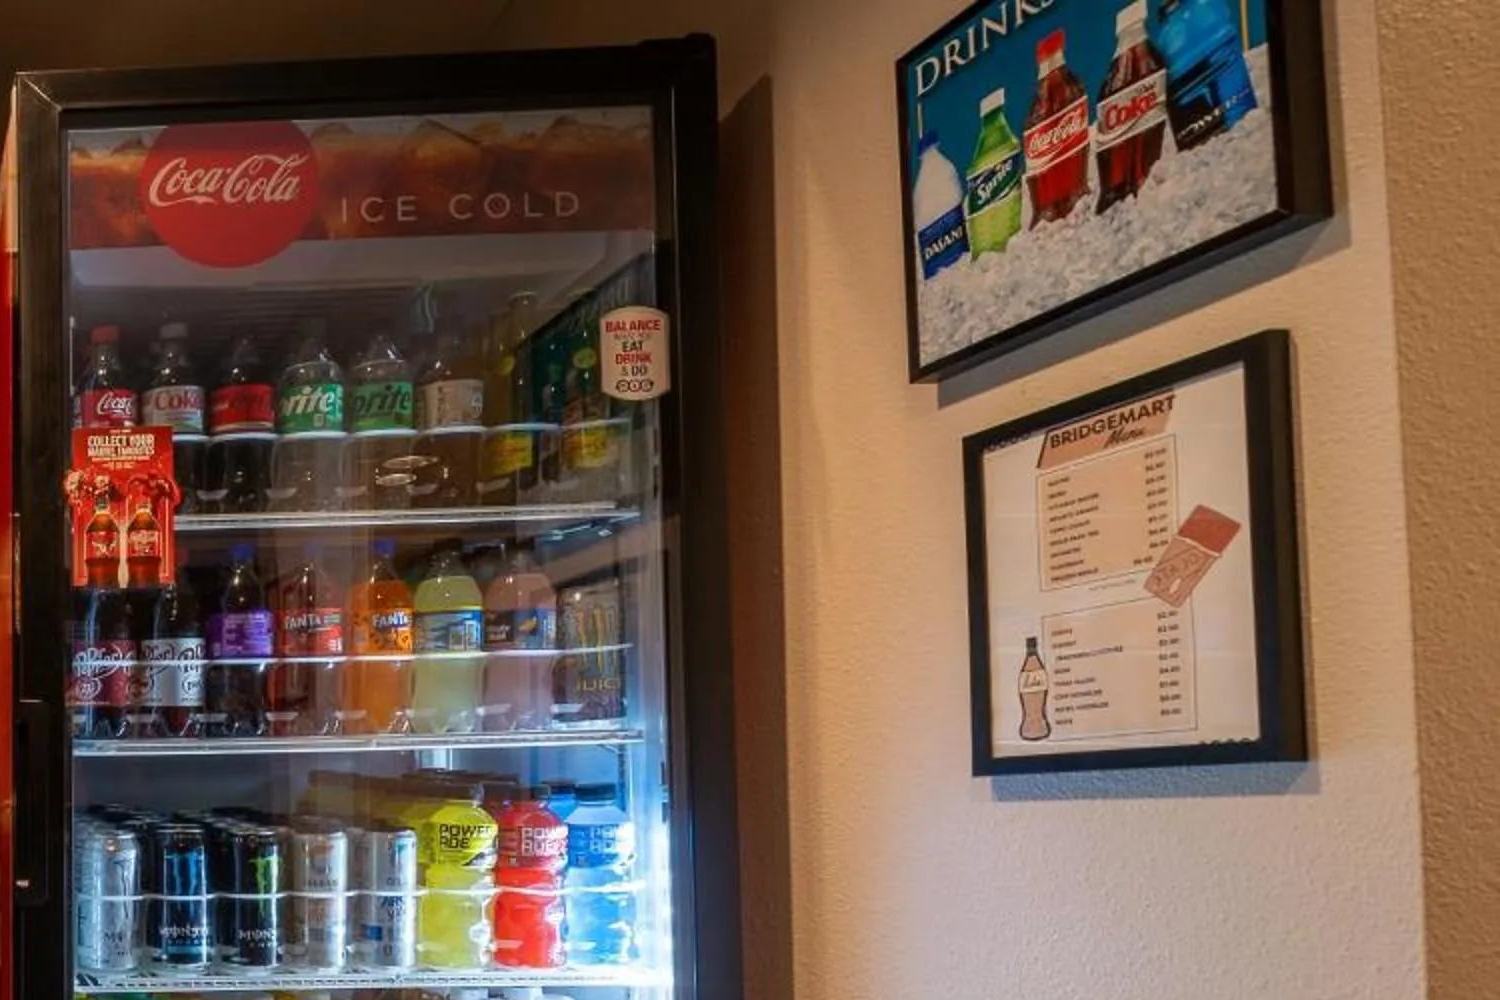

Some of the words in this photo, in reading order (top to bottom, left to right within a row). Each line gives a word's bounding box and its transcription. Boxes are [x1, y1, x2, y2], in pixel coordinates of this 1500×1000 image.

[916, 0, 1055, 96] DRINK
[149, 154, 309, 207] Coca-Cola
[341, 196, 418, 223] ICE
[449, 191, 581, 219] COLD
[605, 319, 661, 332] BALANCE
[1050, 394, 1176, 449] BRIDGEMART
